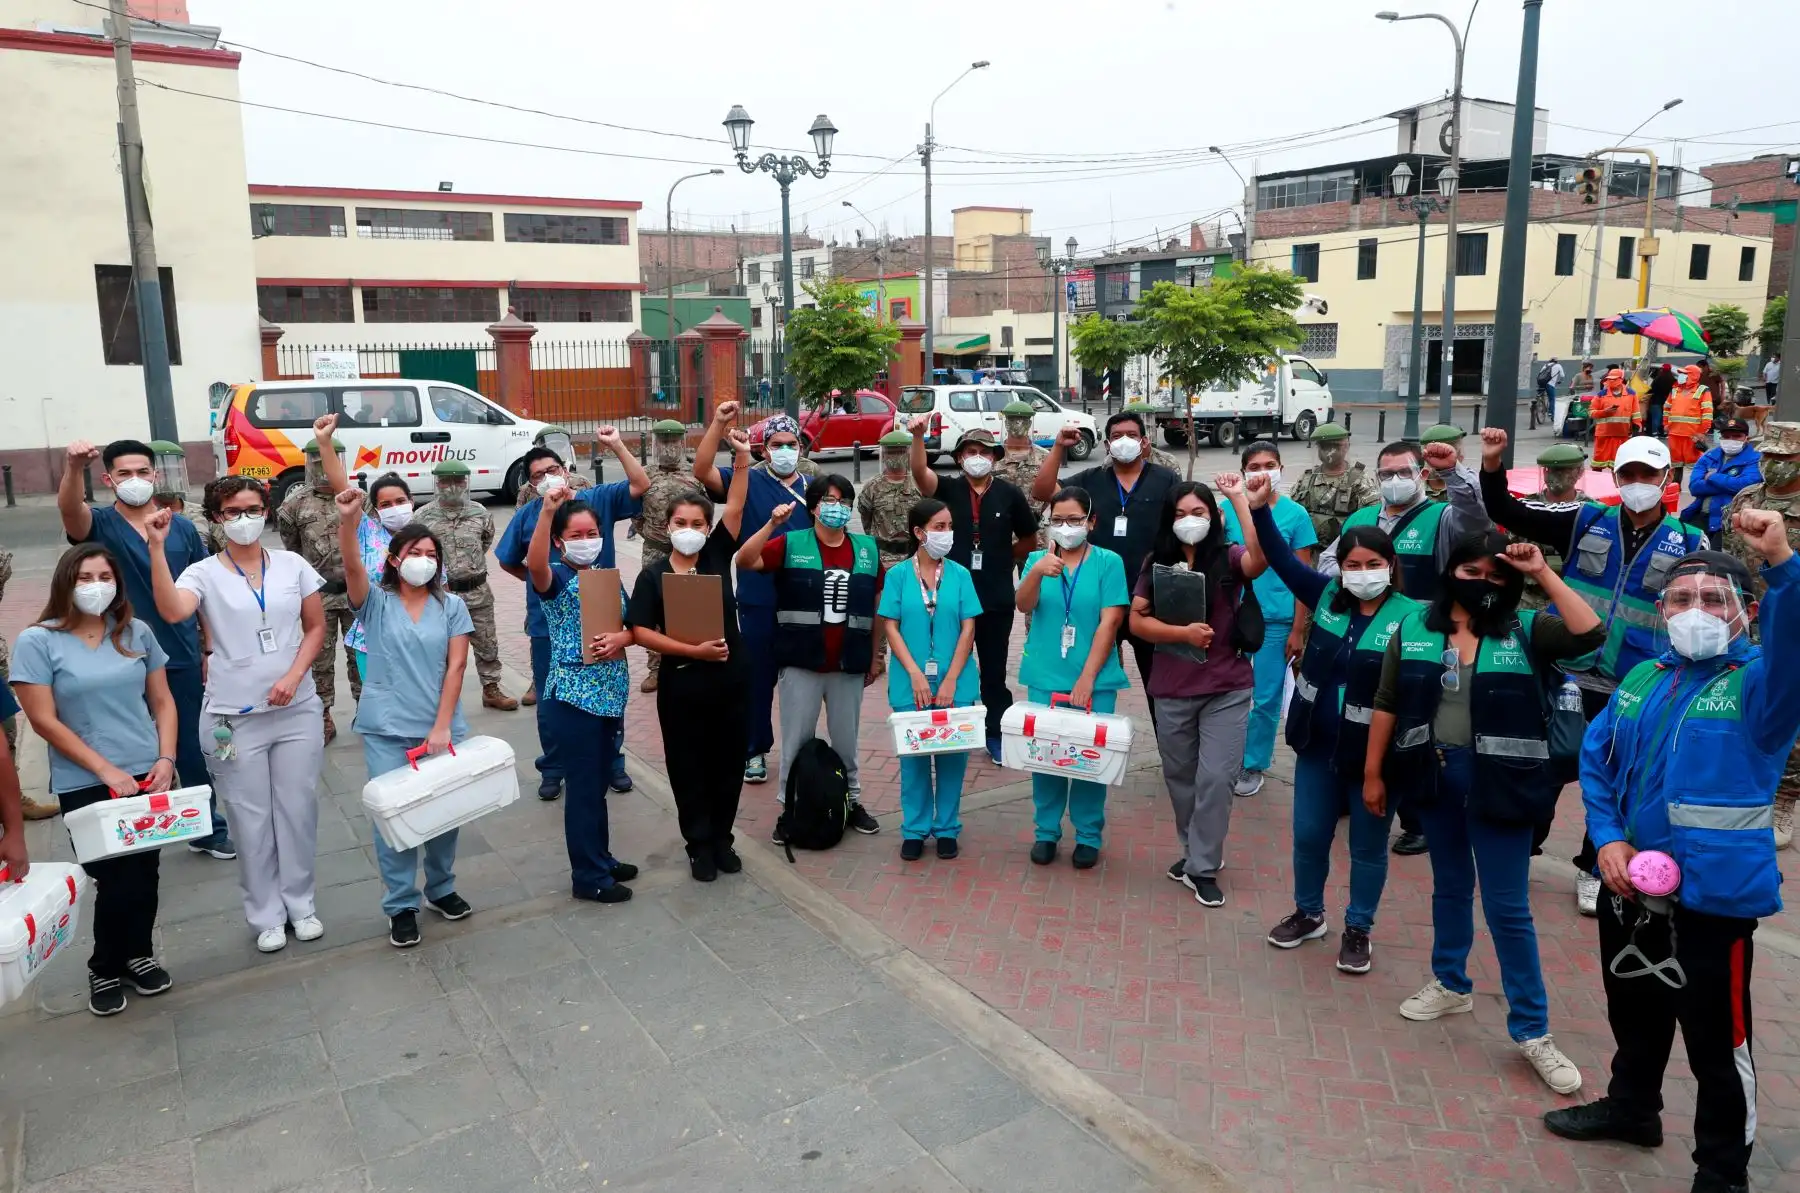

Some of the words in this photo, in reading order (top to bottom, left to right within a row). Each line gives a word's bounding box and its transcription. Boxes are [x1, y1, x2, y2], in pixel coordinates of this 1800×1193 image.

[386, 444, 476, 465] movilbus
[242, 467, 270, 476] F2T-963
[1657, 542, 1685, 556] LIMA
[1493, 656, 1525, 666] LIMA
[1696, 700, 1736, 711] LIMA
